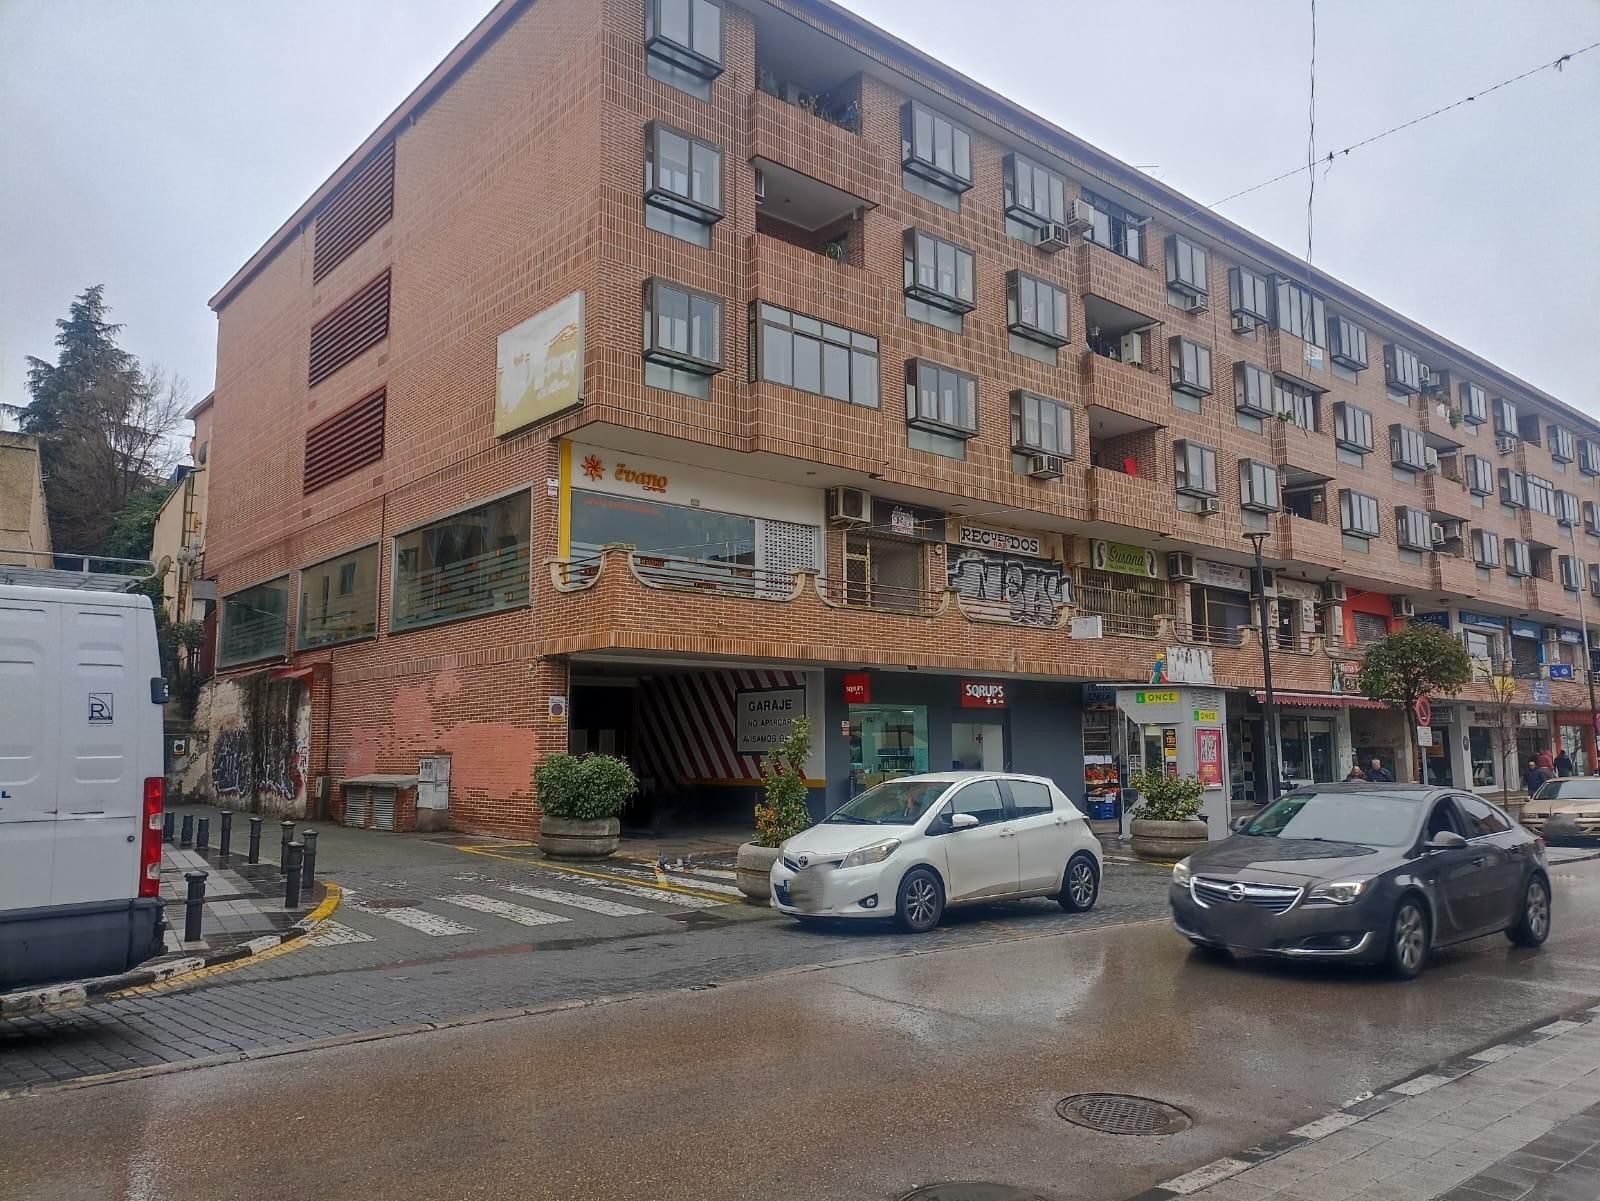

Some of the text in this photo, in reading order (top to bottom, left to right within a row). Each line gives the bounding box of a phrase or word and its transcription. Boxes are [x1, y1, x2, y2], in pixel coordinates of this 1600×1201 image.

[961, 527, 1038, 552] RECUERDOS
[1109, 545, 1144, 567] Susana
[965, 684, 1004, 698] SQRUPS
[1148, 693, 1175, 702] ONCE
[748, 699, 793, 712] GARAJE
[1200, 712, 1216, 720] ONCE
[748, 719, 758, 728] NO
